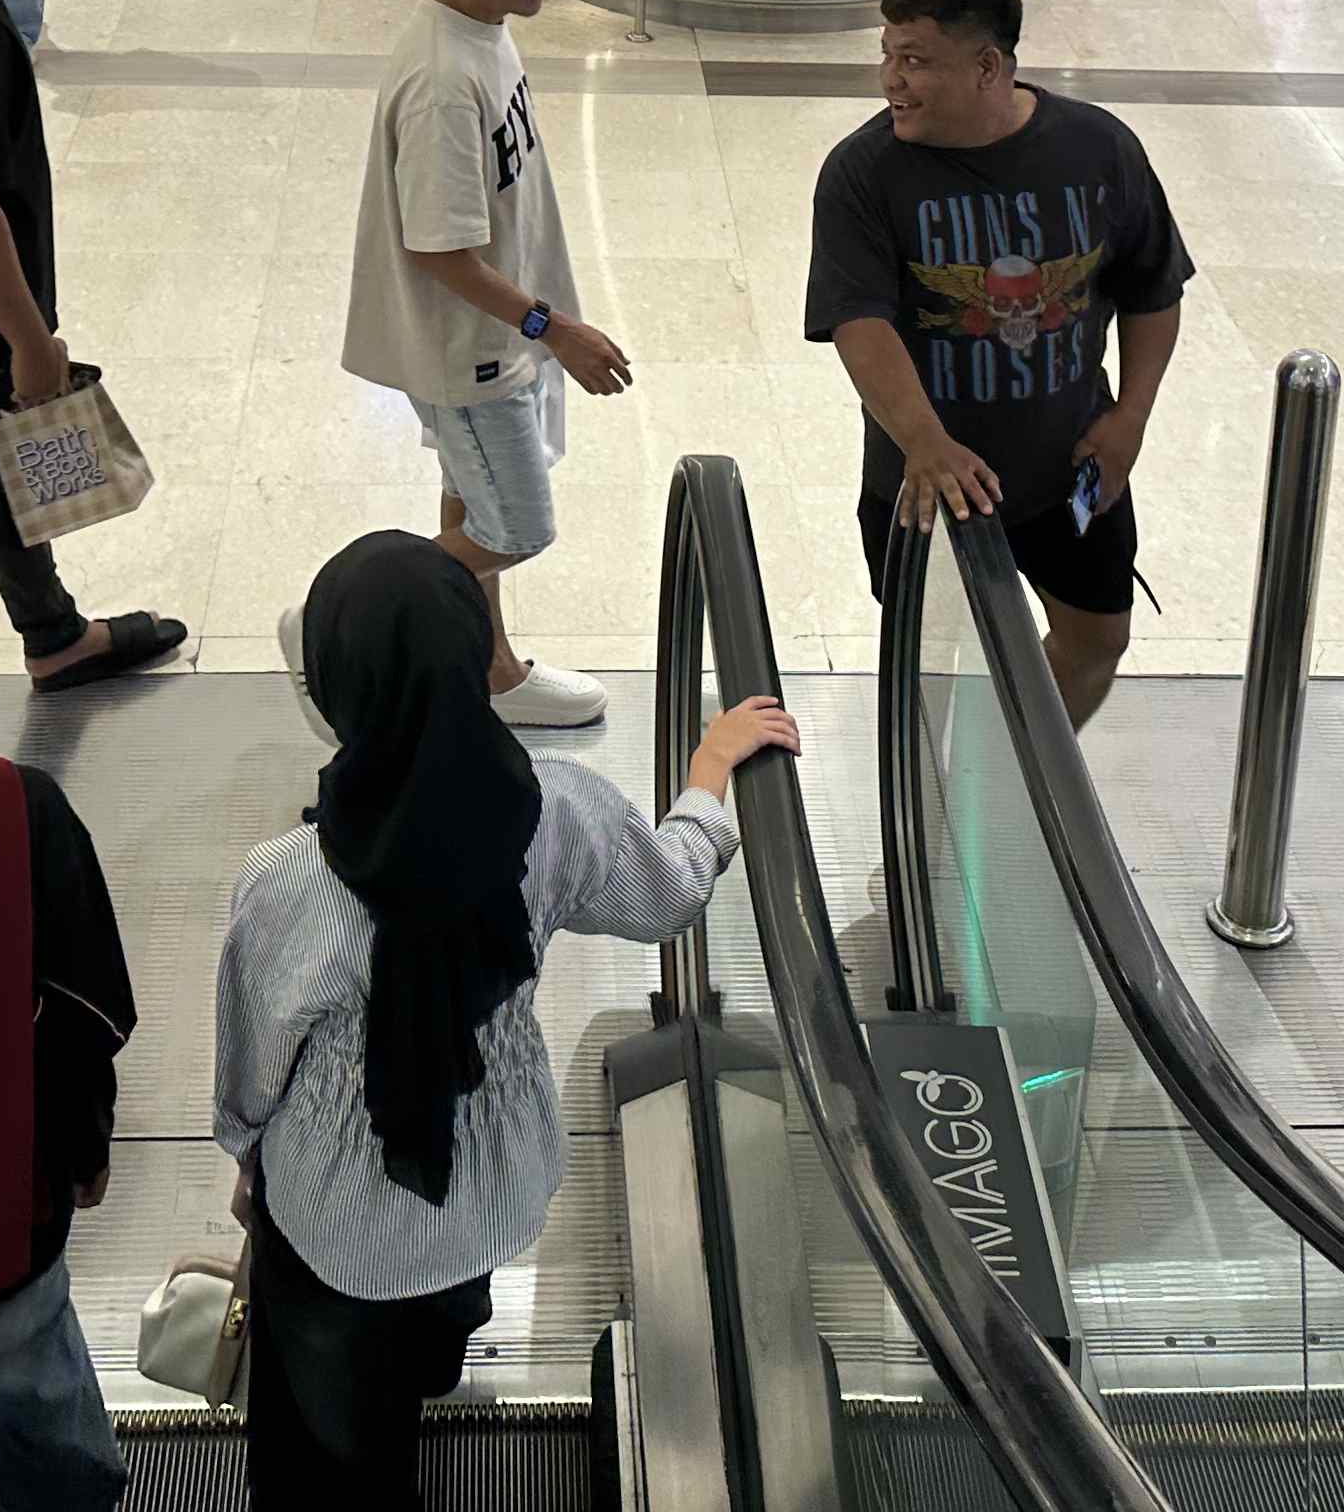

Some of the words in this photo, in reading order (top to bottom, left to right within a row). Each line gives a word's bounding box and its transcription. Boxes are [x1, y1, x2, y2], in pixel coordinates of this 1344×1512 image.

[918, 191, 1044, 266] GUNS
[930, 319, 1083, 403] ROSES
[15, 423, 96, 472] Bath
[43, 449, 100, 480] Body
[30, 467, 106, 505] Works
